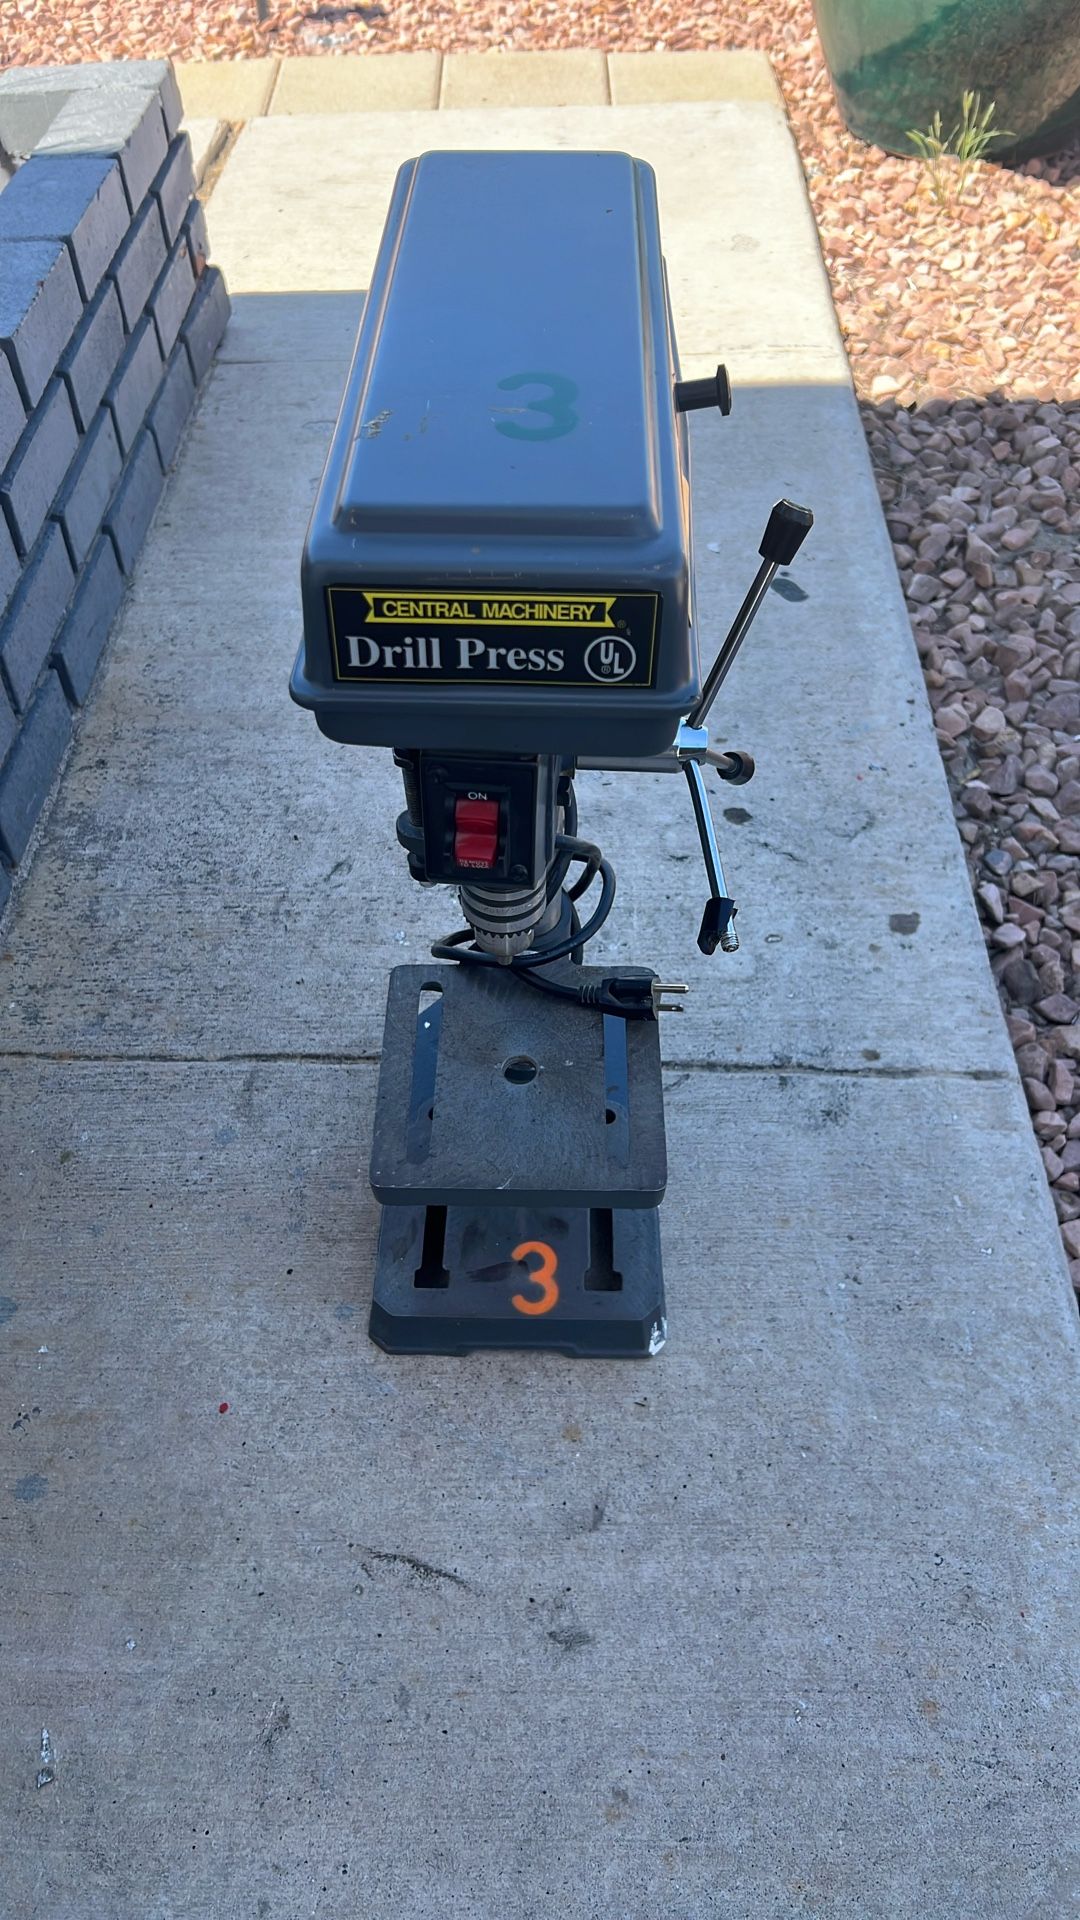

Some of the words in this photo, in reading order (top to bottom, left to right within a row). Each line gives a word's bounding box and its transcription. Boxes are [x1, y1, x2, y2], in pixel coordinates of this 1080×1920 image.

[495, 371, 579, 442] 3
[382, 601, 475, 619] CENTRAL
[482, 603, 596, 621] MACHINERY
[345, 635, 443, 669] Drill
[455, 637, 565, 672] Press
[600, 642, 625, 674] UL
[467, 791, 488, 801] ON
[511, 1241, 559, 1315] 3
